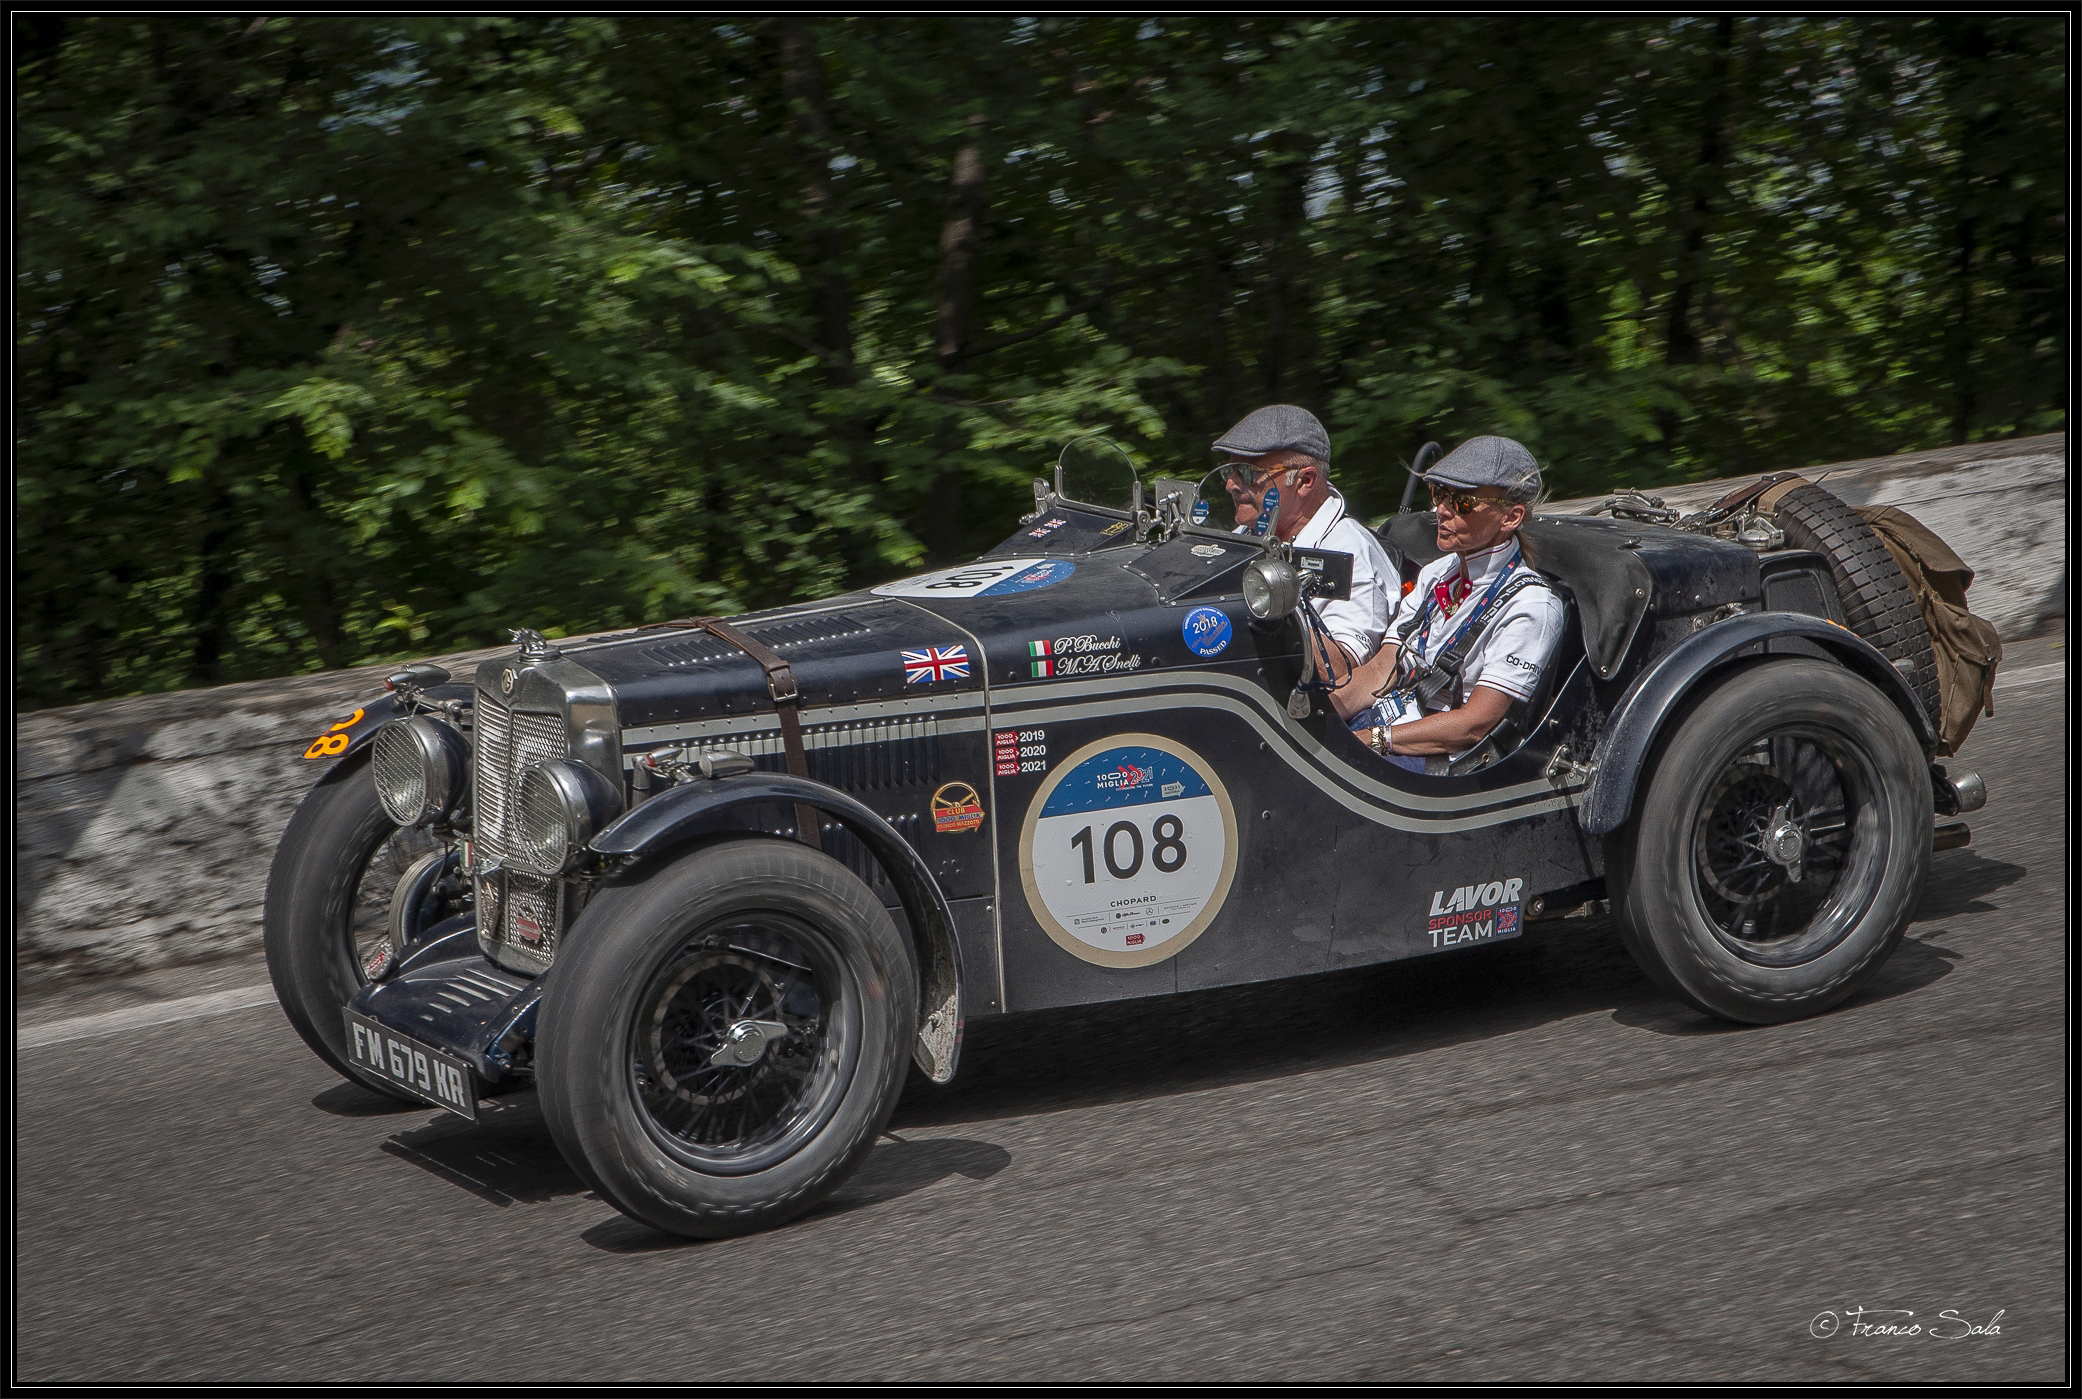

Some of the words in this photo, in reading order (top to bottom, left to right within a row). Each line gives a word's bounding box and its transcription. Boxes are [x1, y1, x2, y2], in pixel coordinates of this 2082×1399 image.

[1192, 615, 1218, 635] 2018
[1199, 640, 1227, 655] PASSED
[1019, 729, 1045, 743] 2019
[1020, 744, 1047, 758] 2020
[1021, 759, 1047, 773] 2021
[1096, 779, 1130, 789] MIGLIA
[958, 813, 981, 821] MIGLIA
[1070, 813, 1188, 885] 108
[1110, 895, 1157, 908] CHOPARD
[1428, 877, 1523, 917] LAVOR
[1428, 909, 1493, 931] SPONSOR
[1428, 920, 1493, 948] TEAM
[352, 1021, 385, 1070] FM
[387, 1038, 431, 1091] 679
[433, 1059, 466, 1108] KR
